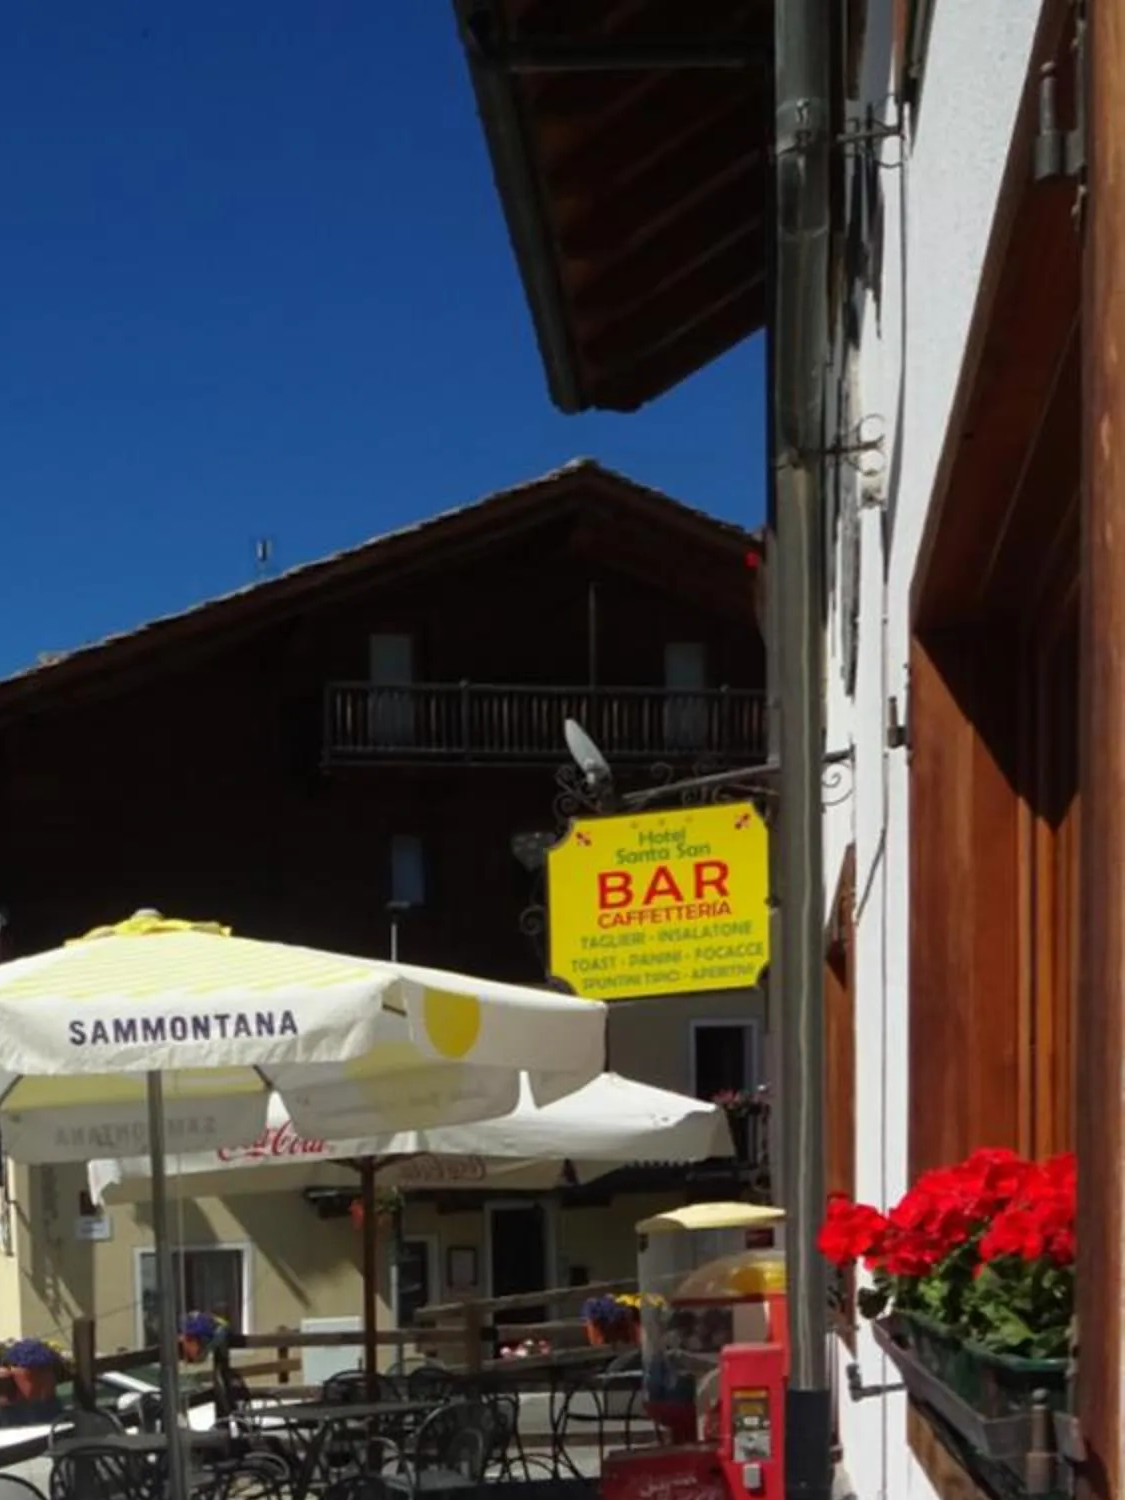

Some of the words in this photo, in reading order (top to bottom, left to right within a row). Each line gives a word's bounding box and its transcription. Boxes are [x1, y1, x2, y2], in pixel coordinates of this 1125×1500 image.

[638, 828, 686, 846] Hotel
[616, 847, 671, 865] Santa
[676, 843, 711, 859] San
[597, 860, 730, 910] BAR
[597, 900, 732, 929] CAFFETTERIA
[571, 955, 617, 973] TOAST
[69, 1010, 299, 1046] SAMMONTANA
